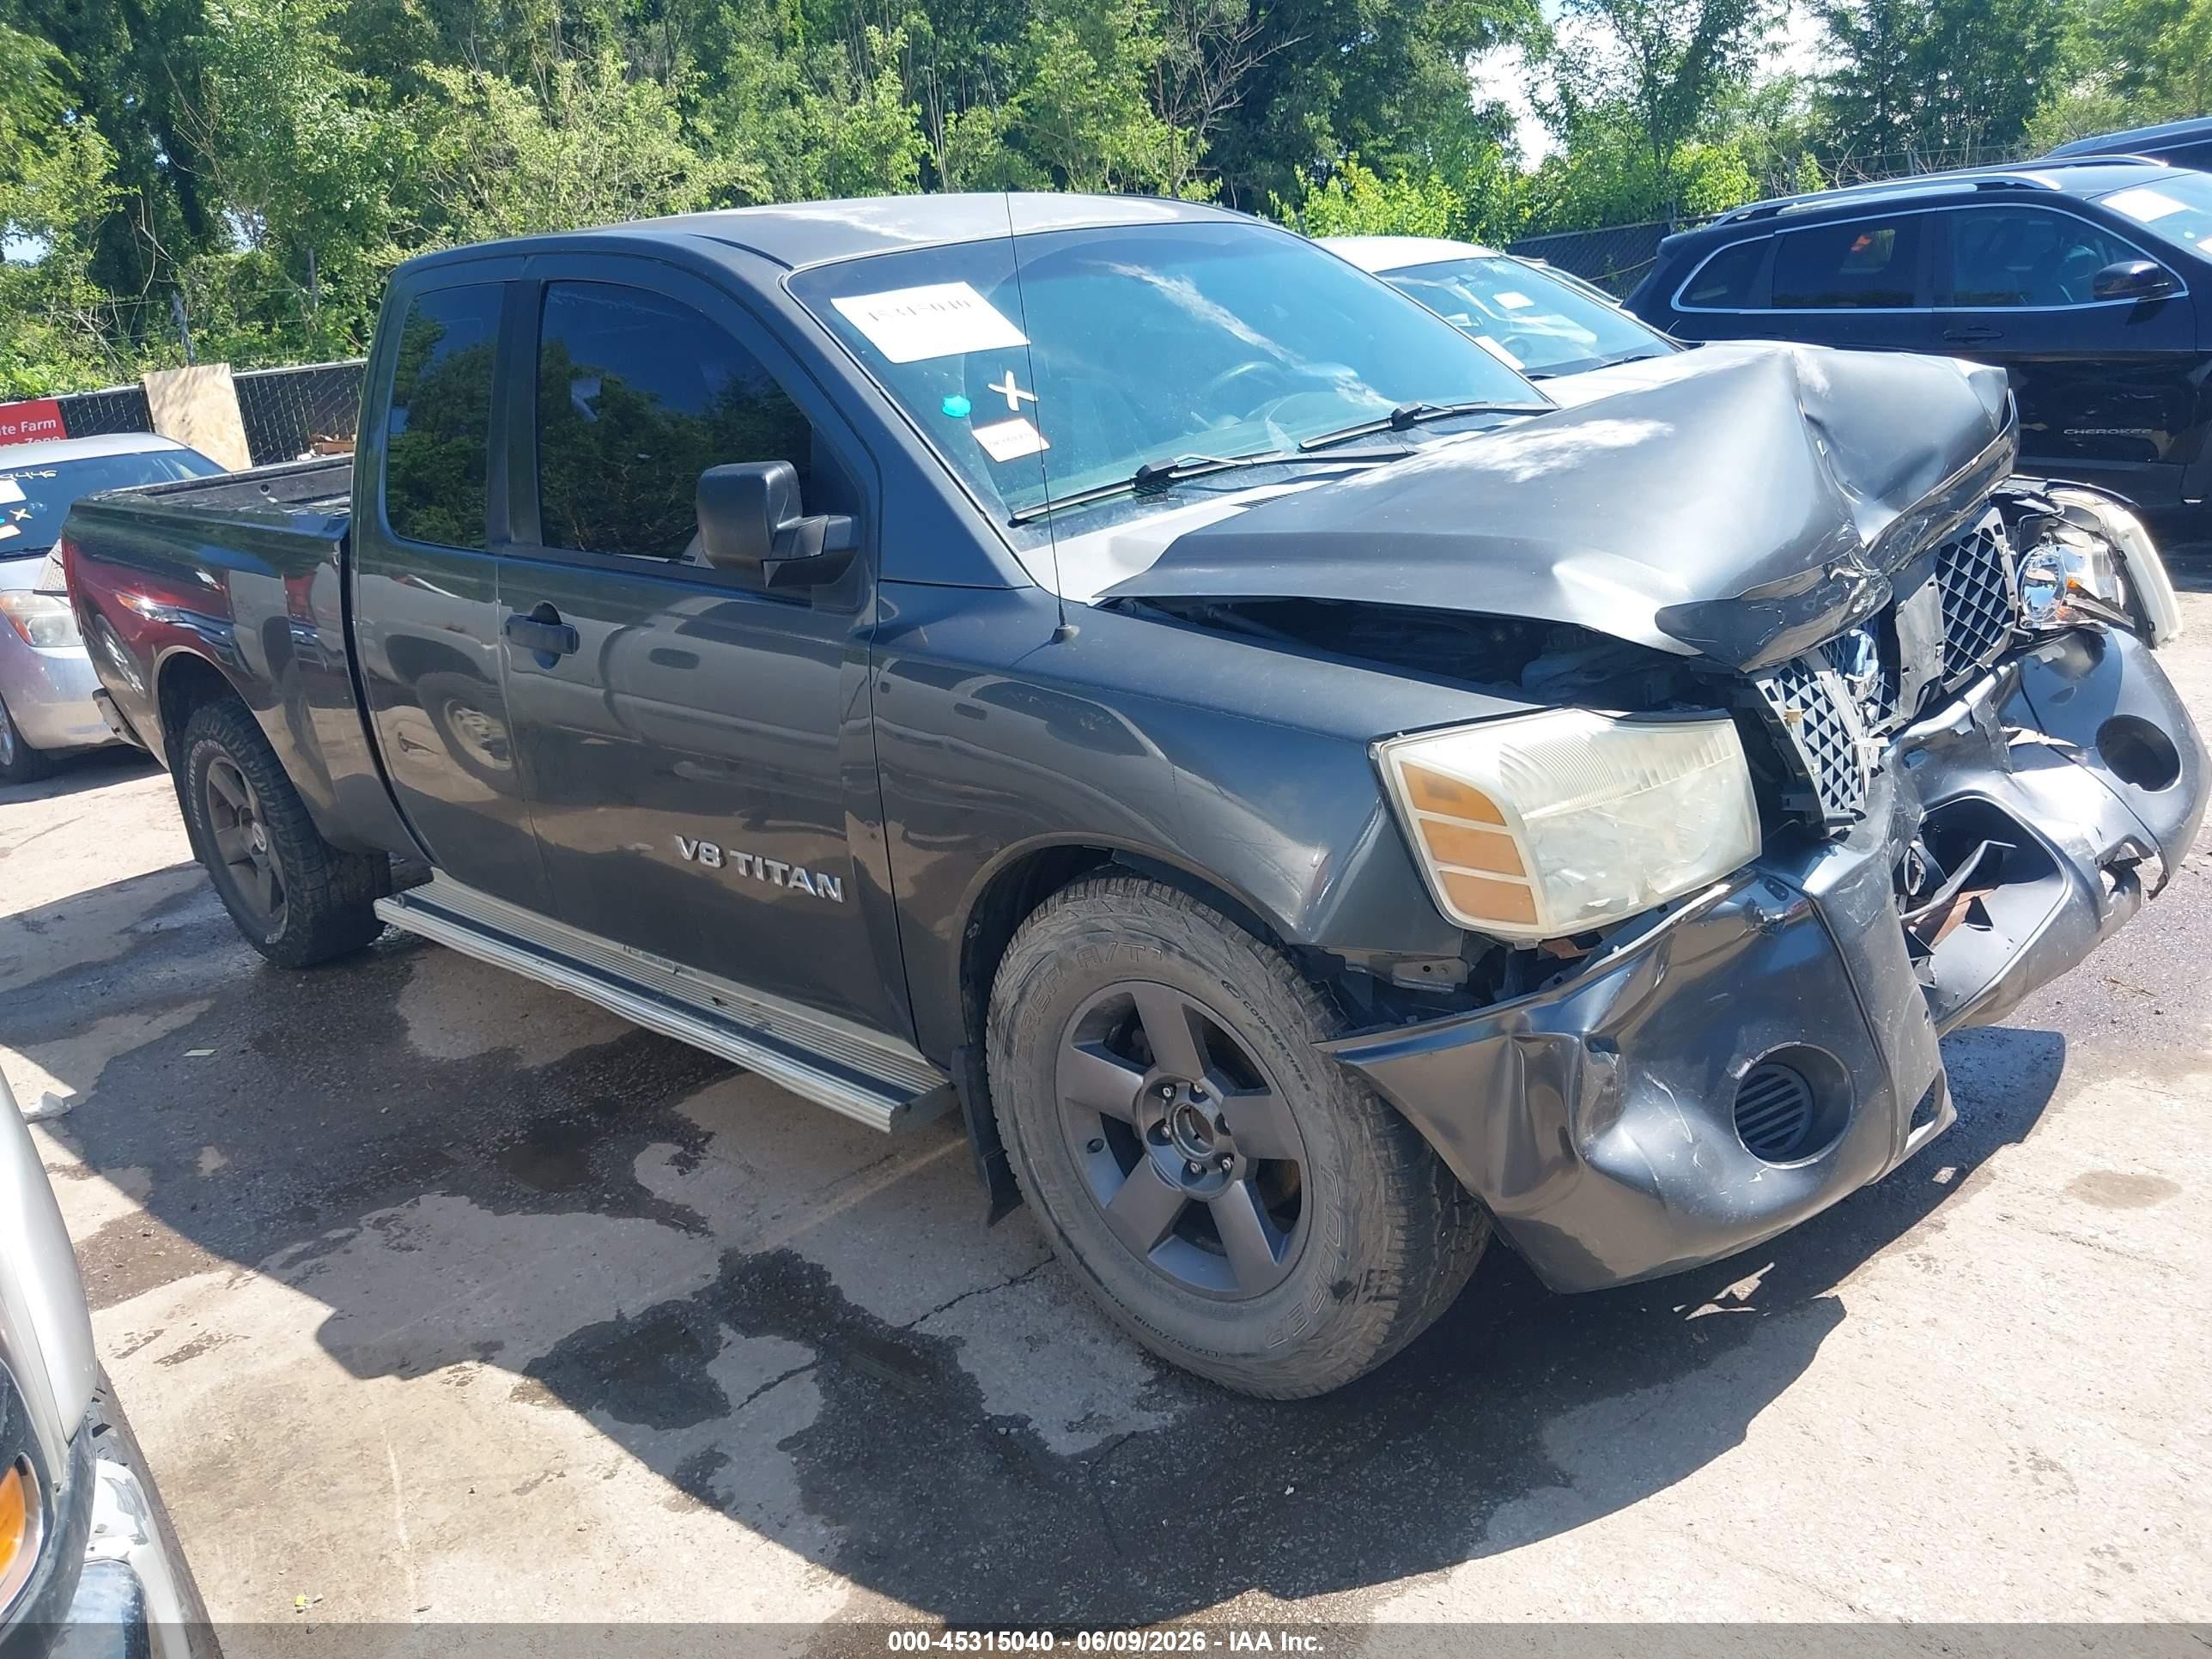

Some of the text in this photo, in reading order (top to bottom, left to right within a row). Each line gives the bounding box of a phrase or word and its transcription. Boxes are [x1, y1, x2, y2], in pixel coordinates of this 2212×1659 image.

[21, 419, 57, 433] Farm
[674, 834, 845, 902] V8 TITAN
[1265, 1162, 1341, 1350] COOPER
